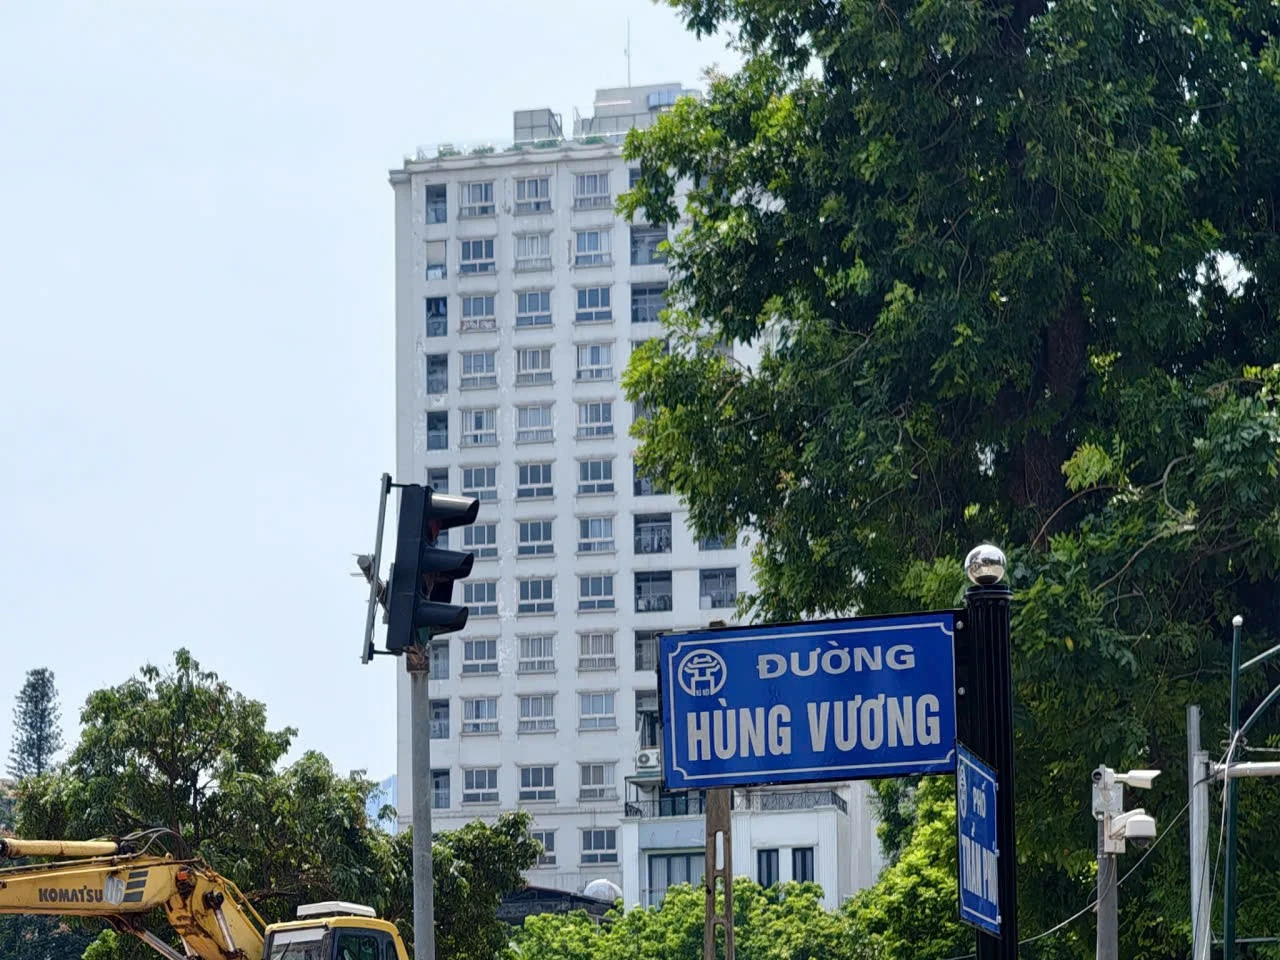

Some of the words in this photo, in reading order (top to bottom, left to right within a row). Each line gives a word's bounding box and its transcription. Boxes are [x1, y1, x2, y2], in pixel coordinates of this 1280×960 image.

[756, 640, 916, 680] ĐƯỜNG
[686, 698, 792, 762] HÙNG
[807, 692, 942, 753] VƯƠNG
[972, 780, 987, 819] PHỐ
[38, 884, 104, 902] KOMATSU
